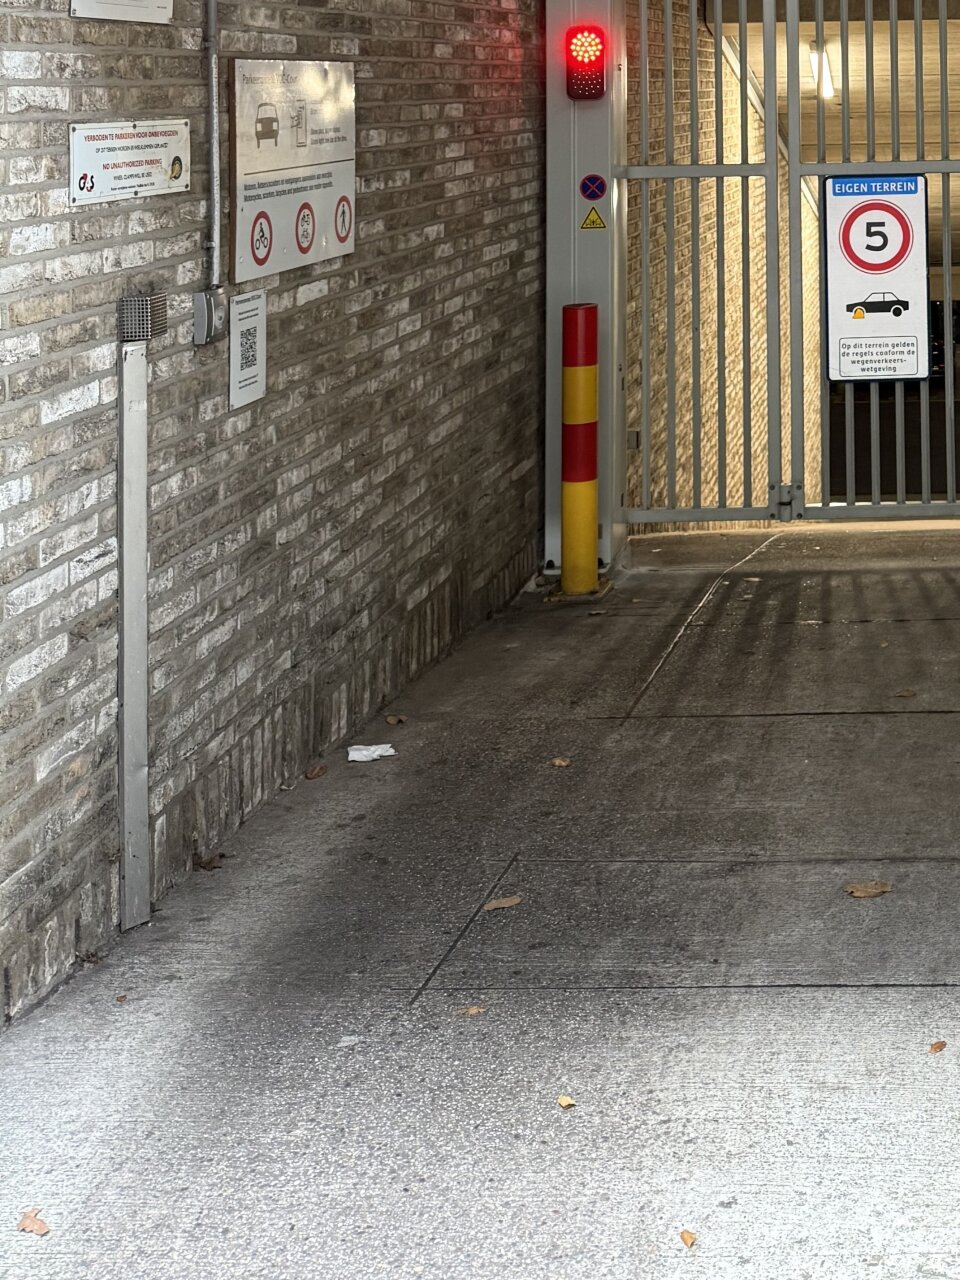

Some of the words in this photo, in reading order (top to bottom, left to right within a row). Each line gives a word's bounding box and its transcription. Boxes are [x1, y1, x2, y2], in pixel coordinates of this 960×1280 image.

[84, 134, 108, 142] VERBODEN
[115, 132, 135, 140] PARKEREN
[148, 130, 178, 138] ONBEVOEGDEN
[103, 162, 110, 170] NO
[111, 160, 144, 169] UNAUTHORIZED
[835, 184, 867, 193] EIGEN
[870, 182, 915, 192] TERREIN
[865, 222, 888, 251] 5
